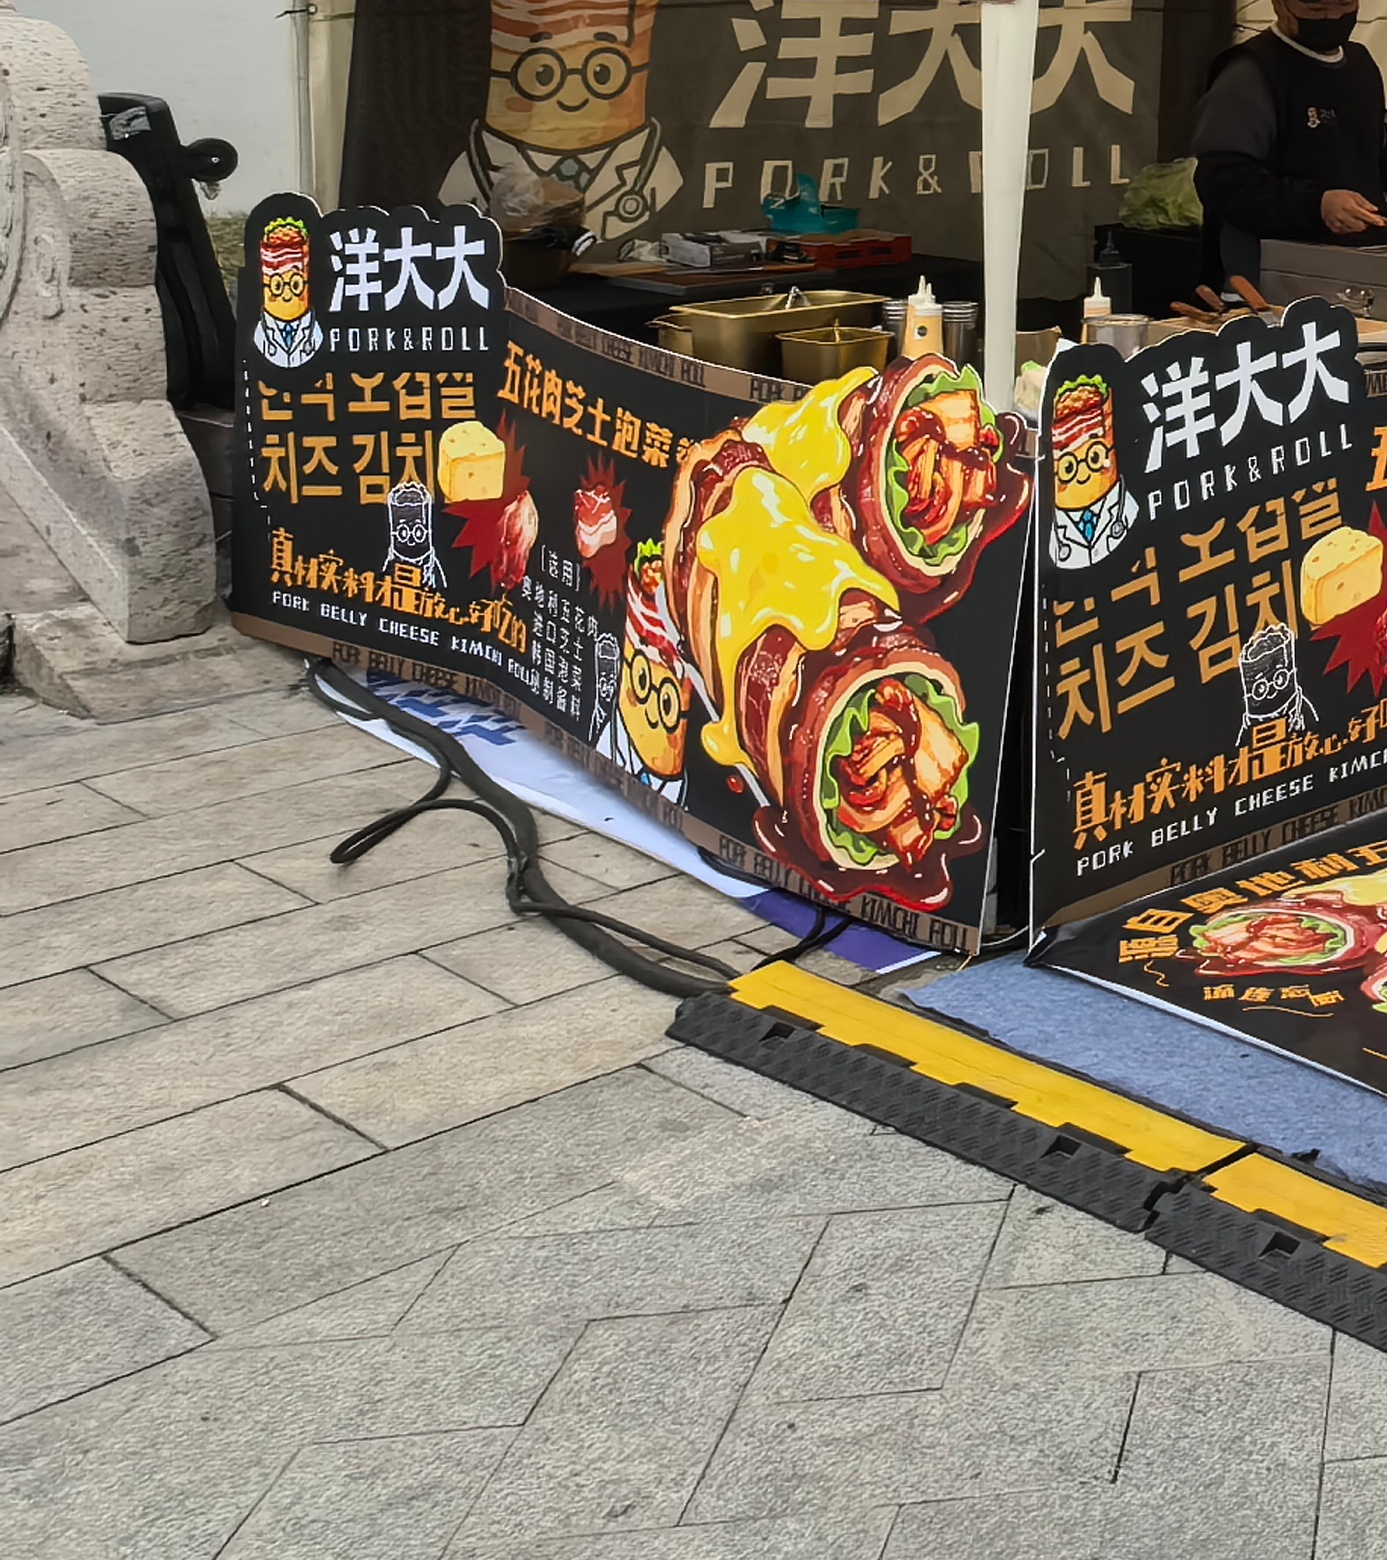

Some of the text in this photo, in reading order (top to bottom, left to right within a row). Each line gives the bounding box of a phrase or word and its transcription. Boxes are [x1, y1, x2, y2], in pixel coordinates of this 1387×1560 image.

[702, 143, 1131, 210] PORK&OLL
[328, 226, 489, 312] 洋大大
[328, 325, 489, 352] PORK&ROLL
[497, 341, 700, 468] 五花肉芝士泡菜
[1143, 319, 1350, 473] 洋大大
[261, 430, 434, 504] 치즈 김치
[1147, 423, 1352, 520] PORK&ROLL
[272, 591, 502, 666] PORK BELLY CHEESE KIMCHI
[1056, 621, 1176, 740] 치즈
[1186, 559, 1298, 684] 김치
[1076, 841, 1134, 877] PORK
[1151, 807, 1217, 848] BELLY
[1235, 774, 1314, 816] CHEESE
